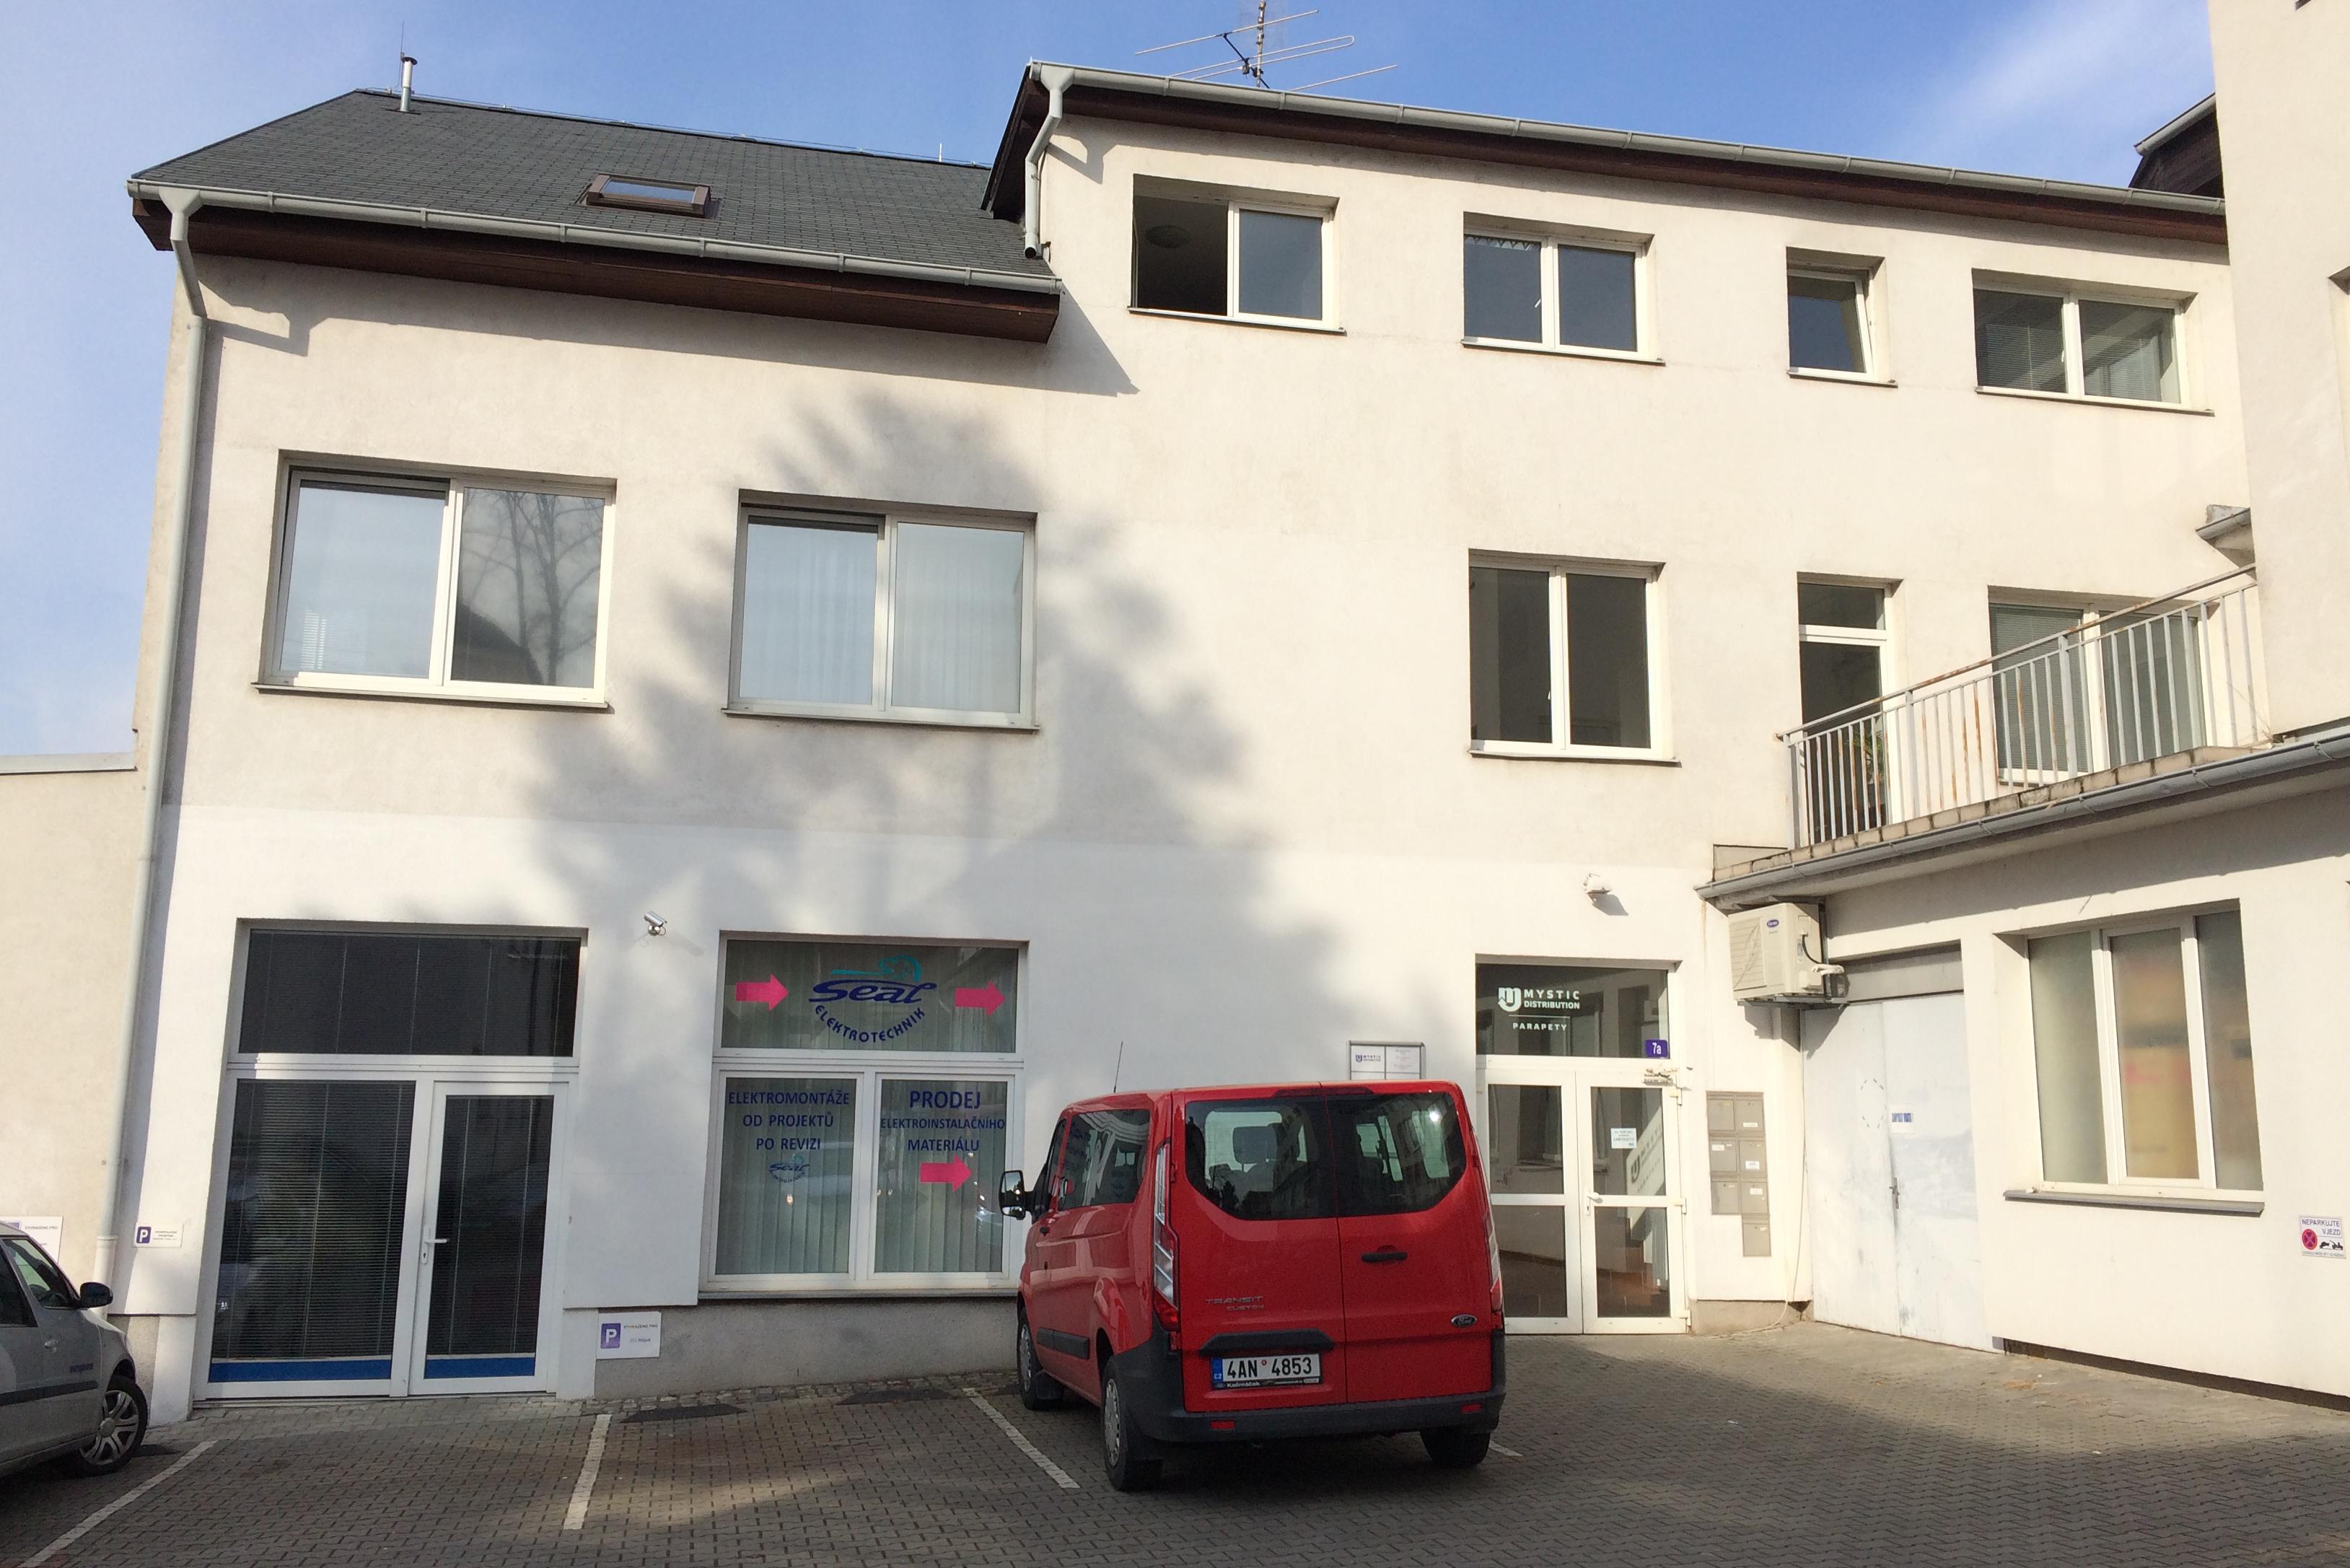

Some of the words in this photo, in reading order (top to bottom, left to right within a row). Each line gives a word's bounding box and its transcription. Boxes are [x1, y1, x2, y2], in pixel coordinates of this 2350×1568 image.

[808, 979, 937, 1004] Seal
[1524, 989, 1580, 1000] MYSTIC
[1524, 1000, 1580, 1009] DISTRIBUTION
[815, 1004, 926, 1043] ELEKTROTECHNIK
[1512, 1022, 1568, 1030] PARAPETY
[1652, 1041, 1662, 1055] 7a
[728, 1089, 850, 1105] ELEKTROMONTÁŽE
[909, 1090, 981, 1110] PRODEJ
[742, 1115, 762, 1128] OD
[768, 1111, 834, 1128] PROJEKTŮ
[880, 1116, 1006, 1130] ELEKTROINSTALAČNÍHO
[756, 1138, 775, 1151] PO
[781, 1137, 821, 1150] REVIZI
[907, 1136, 980, 1152] MATERIÁLU
[2302, 1219, 2340, 1227] NEPARKUJTE
[139, 1229, 149, 1243] P
[1204, 1296, 1263, 1305] TRANSIT
[605, 1328, 618, 1344] P
[1227, 1359, 1258, 1379] 4AN
[1271, 1357, 1312, 1376] 4853
